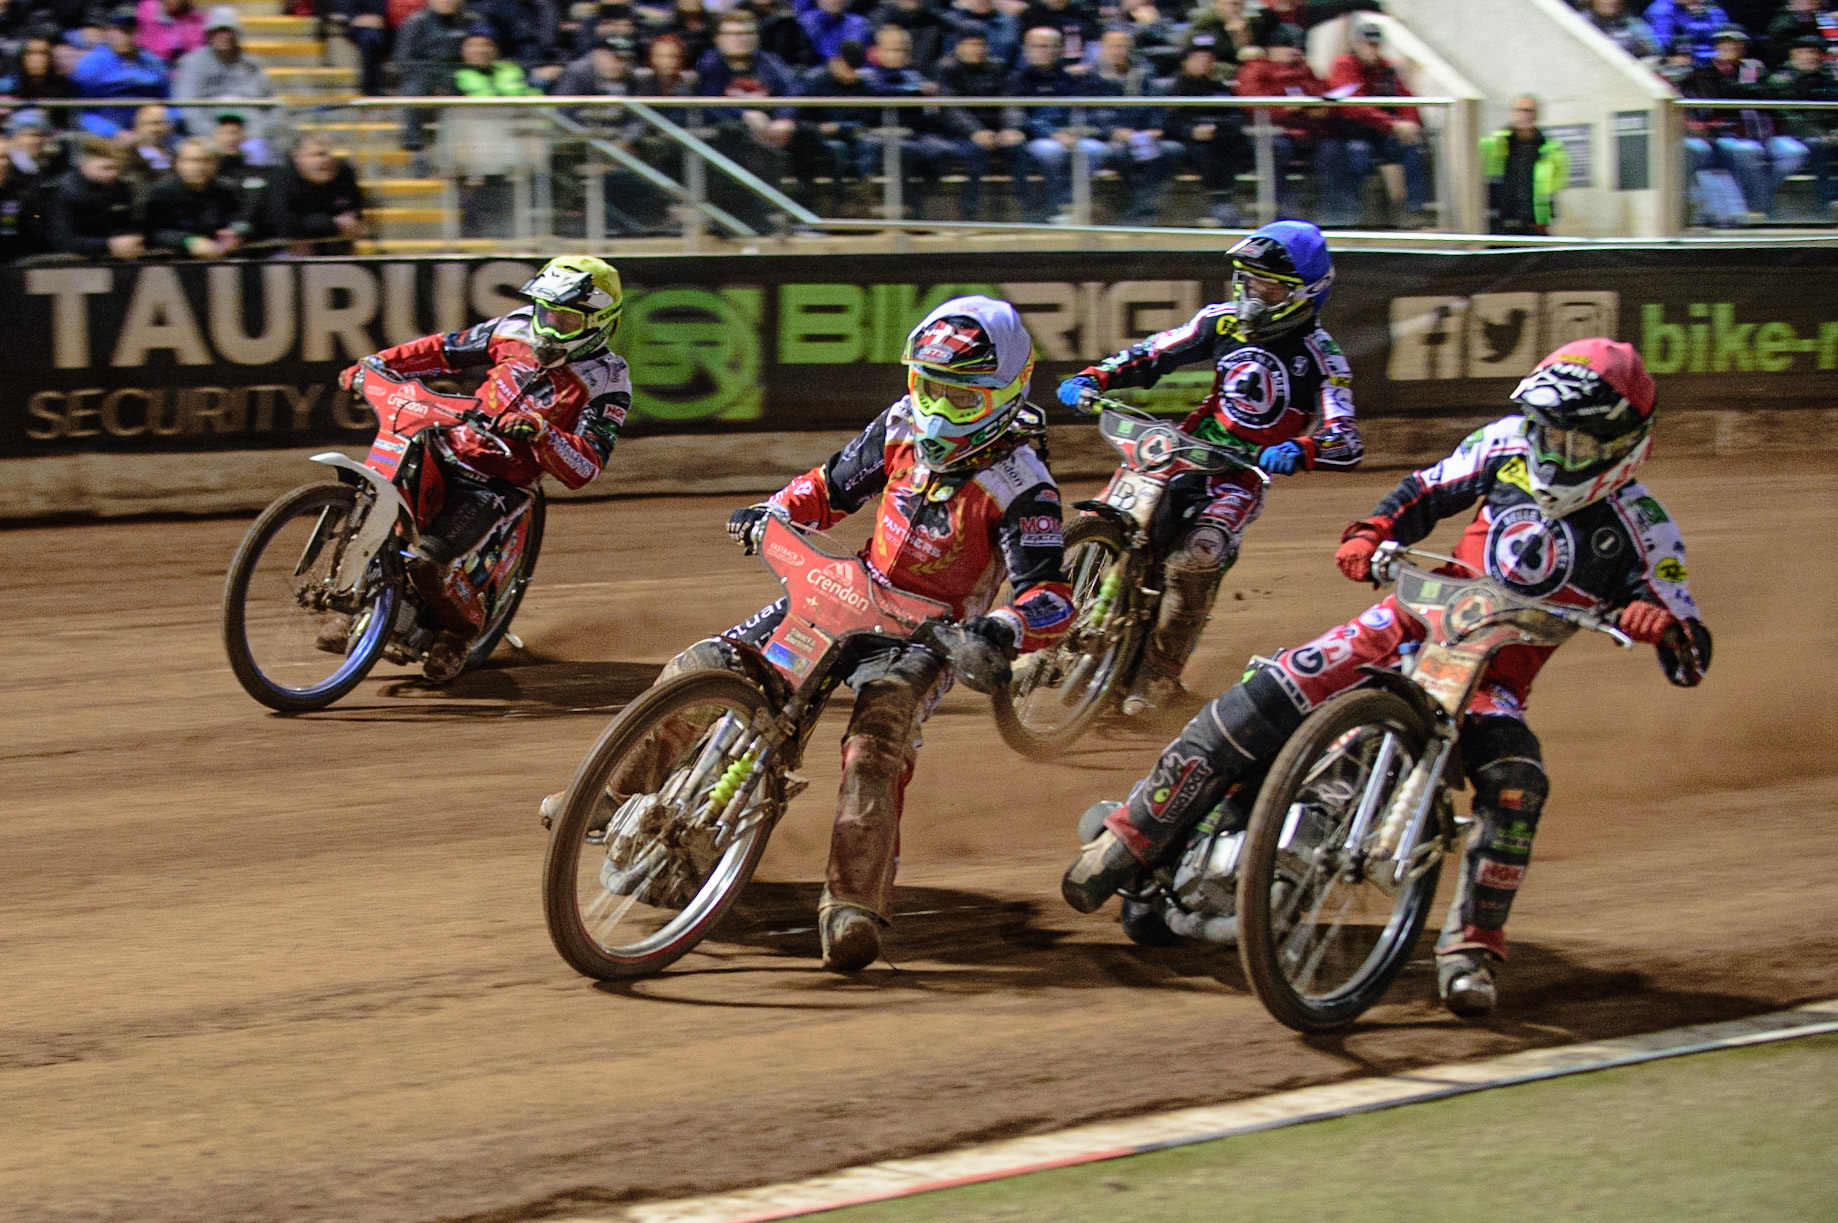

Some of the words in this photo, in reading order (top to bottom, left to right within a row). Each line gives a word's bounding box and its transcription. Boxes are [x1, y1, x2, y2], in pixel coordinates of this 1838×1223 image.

[26, 384, 326, 439] SECURITY
[882, 514, 941, 558] PANTHERS
[806, 568, 871, 612] Crendon
